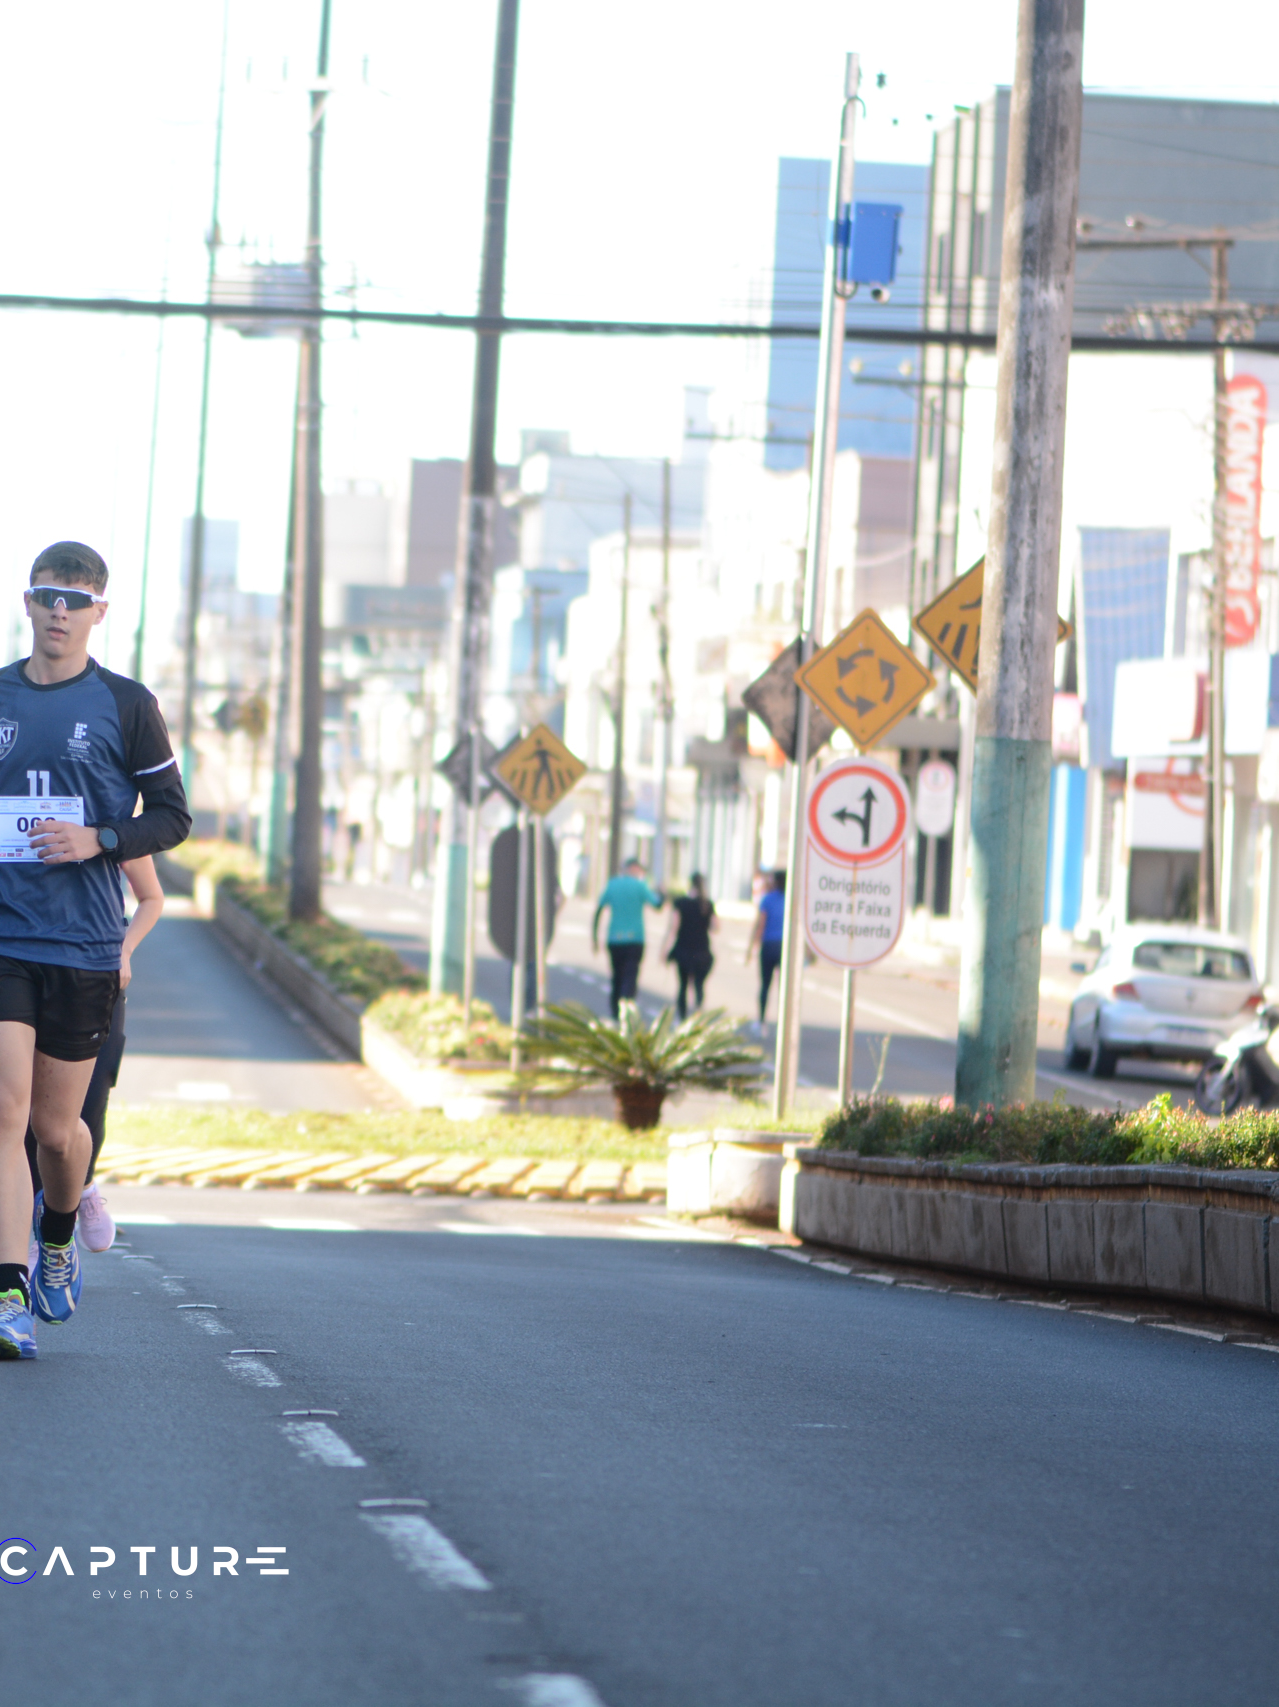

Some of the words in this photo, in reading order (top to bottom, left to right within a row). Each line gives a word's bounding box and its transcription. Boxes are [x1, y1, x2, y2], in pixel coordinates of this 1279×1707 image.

[818, 876, 891, 897] Obrigatório
[814, 900, 842, 916] para
[846, 902, 854, 914] a
[857, 901, 891, 917] Faixa
[811, 920, 827, 934] da
[830, 919, 891, 939] Esquerda
